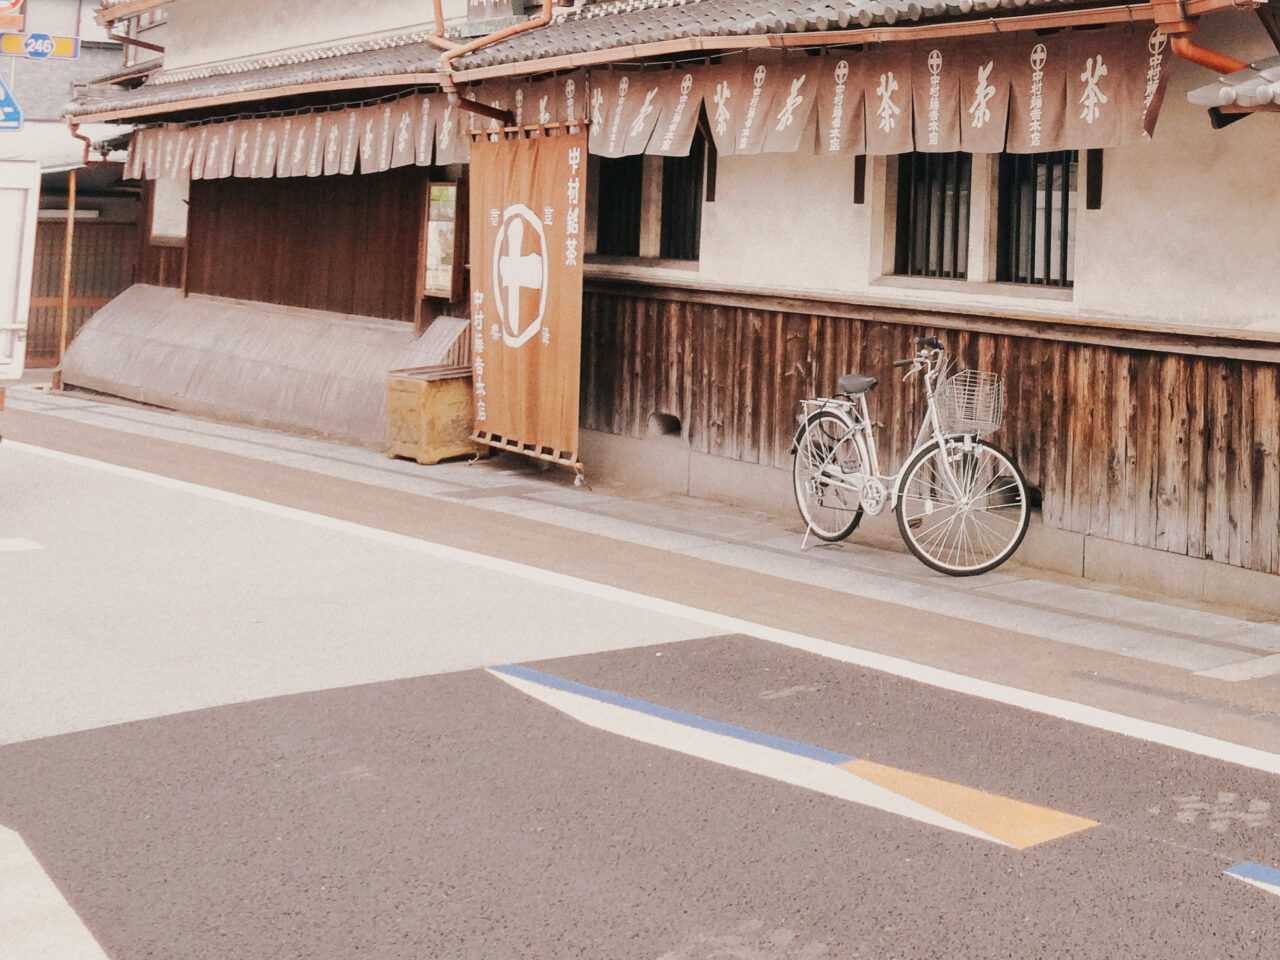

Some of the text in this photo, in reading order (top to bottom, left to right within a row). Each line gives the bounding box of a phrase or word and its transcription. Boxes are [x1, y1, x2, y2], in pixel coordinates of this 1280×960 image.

[27, 39, 52, 53] 246
[876, 71, 901, 134] 茶
[1078, 54, 1108, 125] 茶
